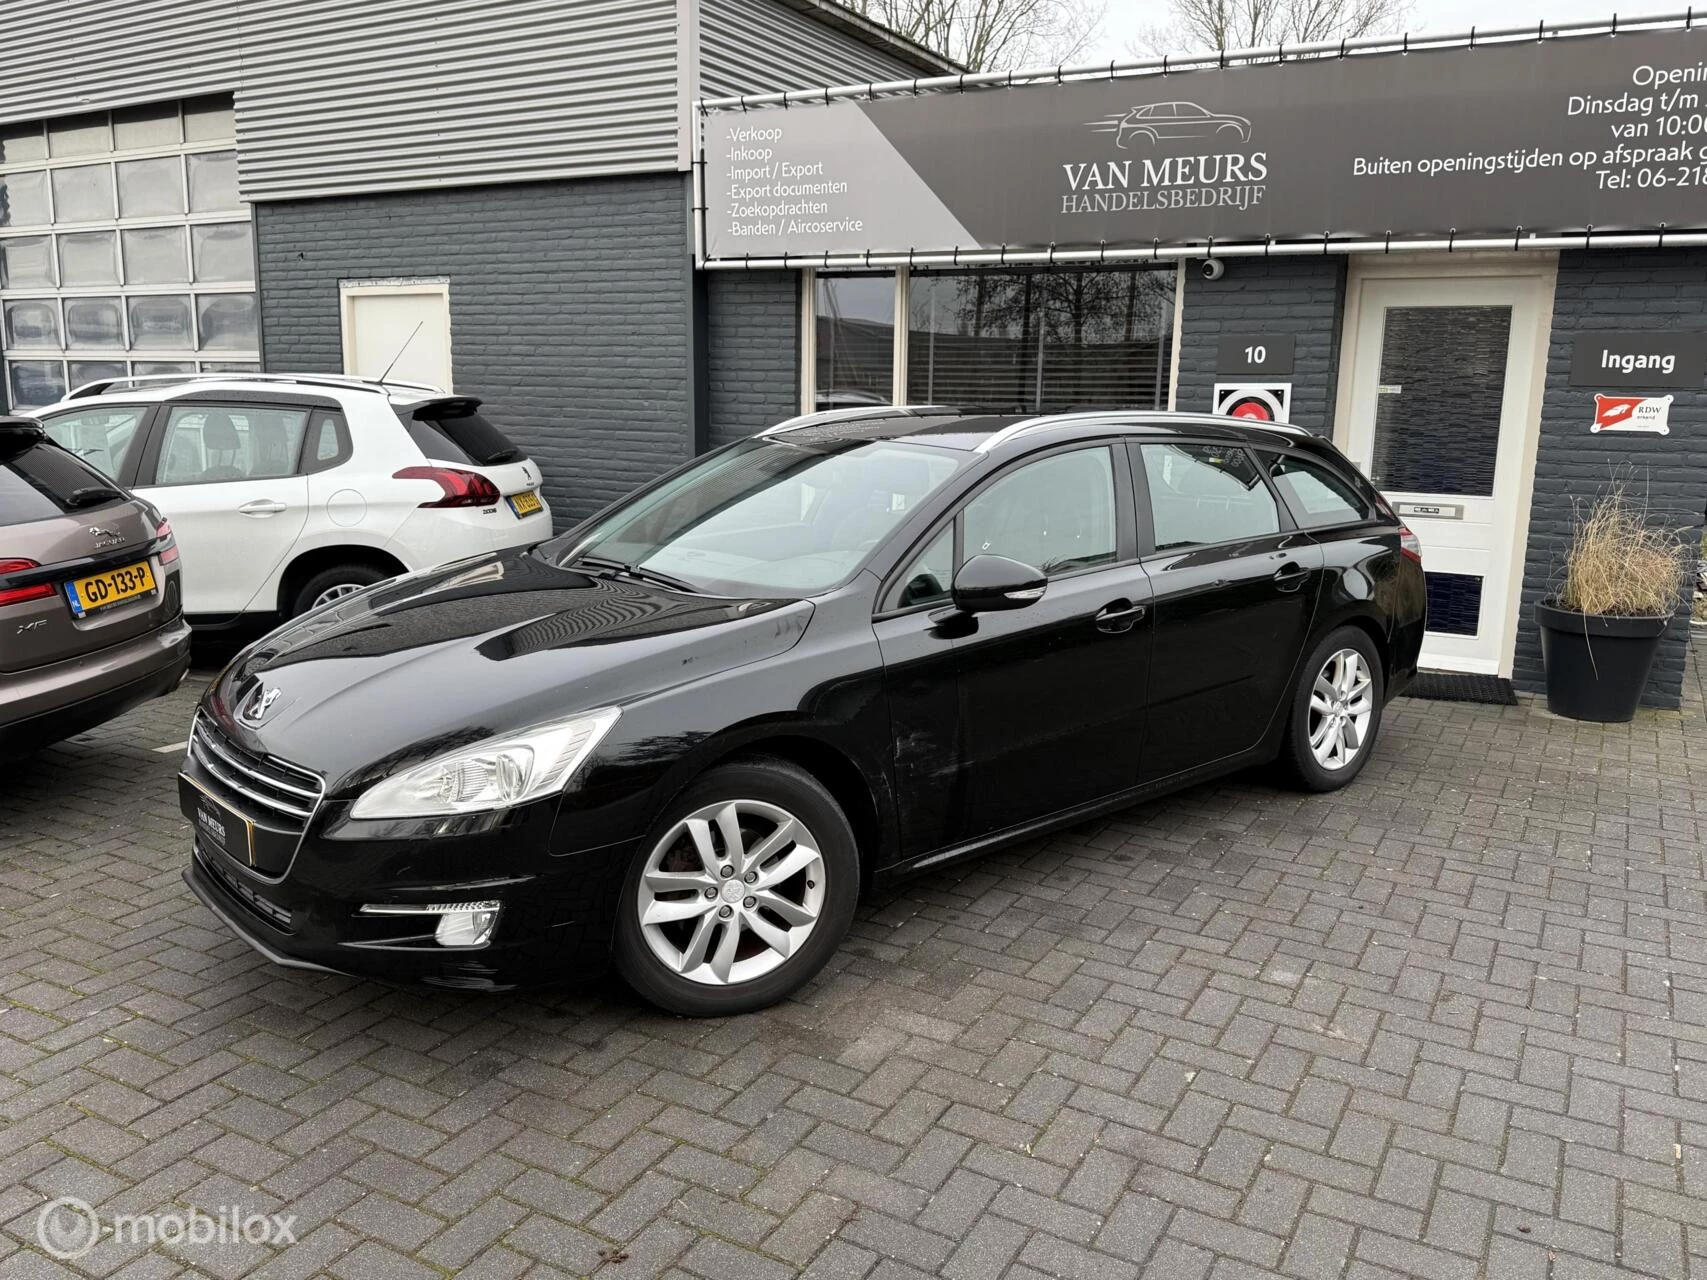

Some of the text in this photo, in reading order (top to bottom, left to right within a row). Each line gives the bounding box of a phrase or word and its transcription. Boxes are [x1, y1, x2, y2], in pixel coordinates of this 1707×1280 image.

[1567, 91, 1654, 116] Dinsdag
[1660, 88, 1699, 112] t/m
[1610, 122, 1649, 138] van
[1353, 157, 1412, 176] Buiten
[1417, 148, 1563, 177] openingstijden
[1568, 150, 1598, 170] op
[1602, 139, 1694, 168] afspraak
[781, 161, 823, 179] Export
[1062, 152, 1268, 190] VAN MEURS
[1596, 169, 1632, 189] Tel:
[773, 181, 847, 196] documenten
[1060, 185, 1267, 214] HANDELSBEDRIJF
[787, 217, 864, 235] Aircoservice
[1244, 345, 1267, 364] 10
[1601, 349, 1676, 375] Ingang
[1638, 406, 1661, 414] RDW
[84, 567, 146, 603] GD-133-P
